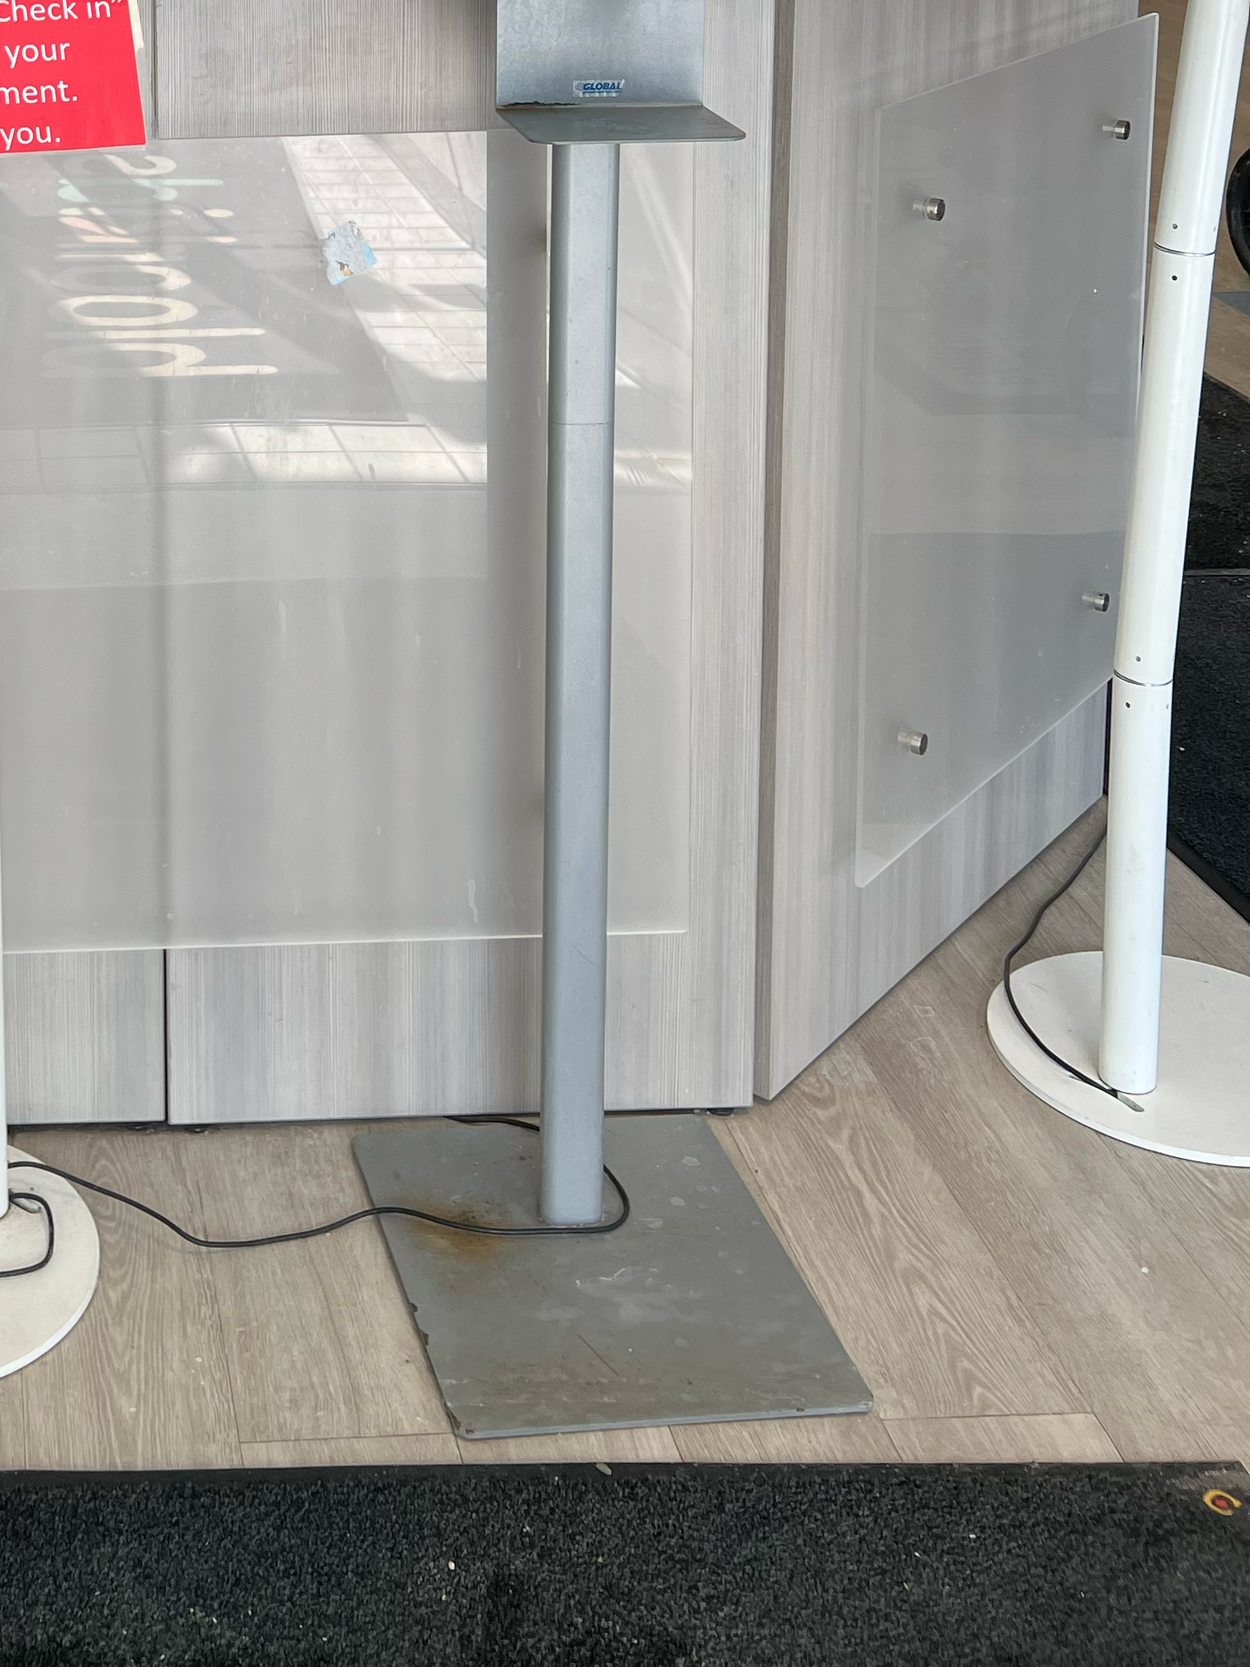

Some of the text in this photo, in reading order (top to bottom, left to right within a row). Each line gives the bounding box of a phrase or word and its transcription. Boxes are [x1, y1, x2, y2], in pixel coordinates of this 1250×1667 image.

[4, 42, 70, 68] your
[583, 82, 622, 90] GLOBAL
[0, 125, 61, 151] you.
